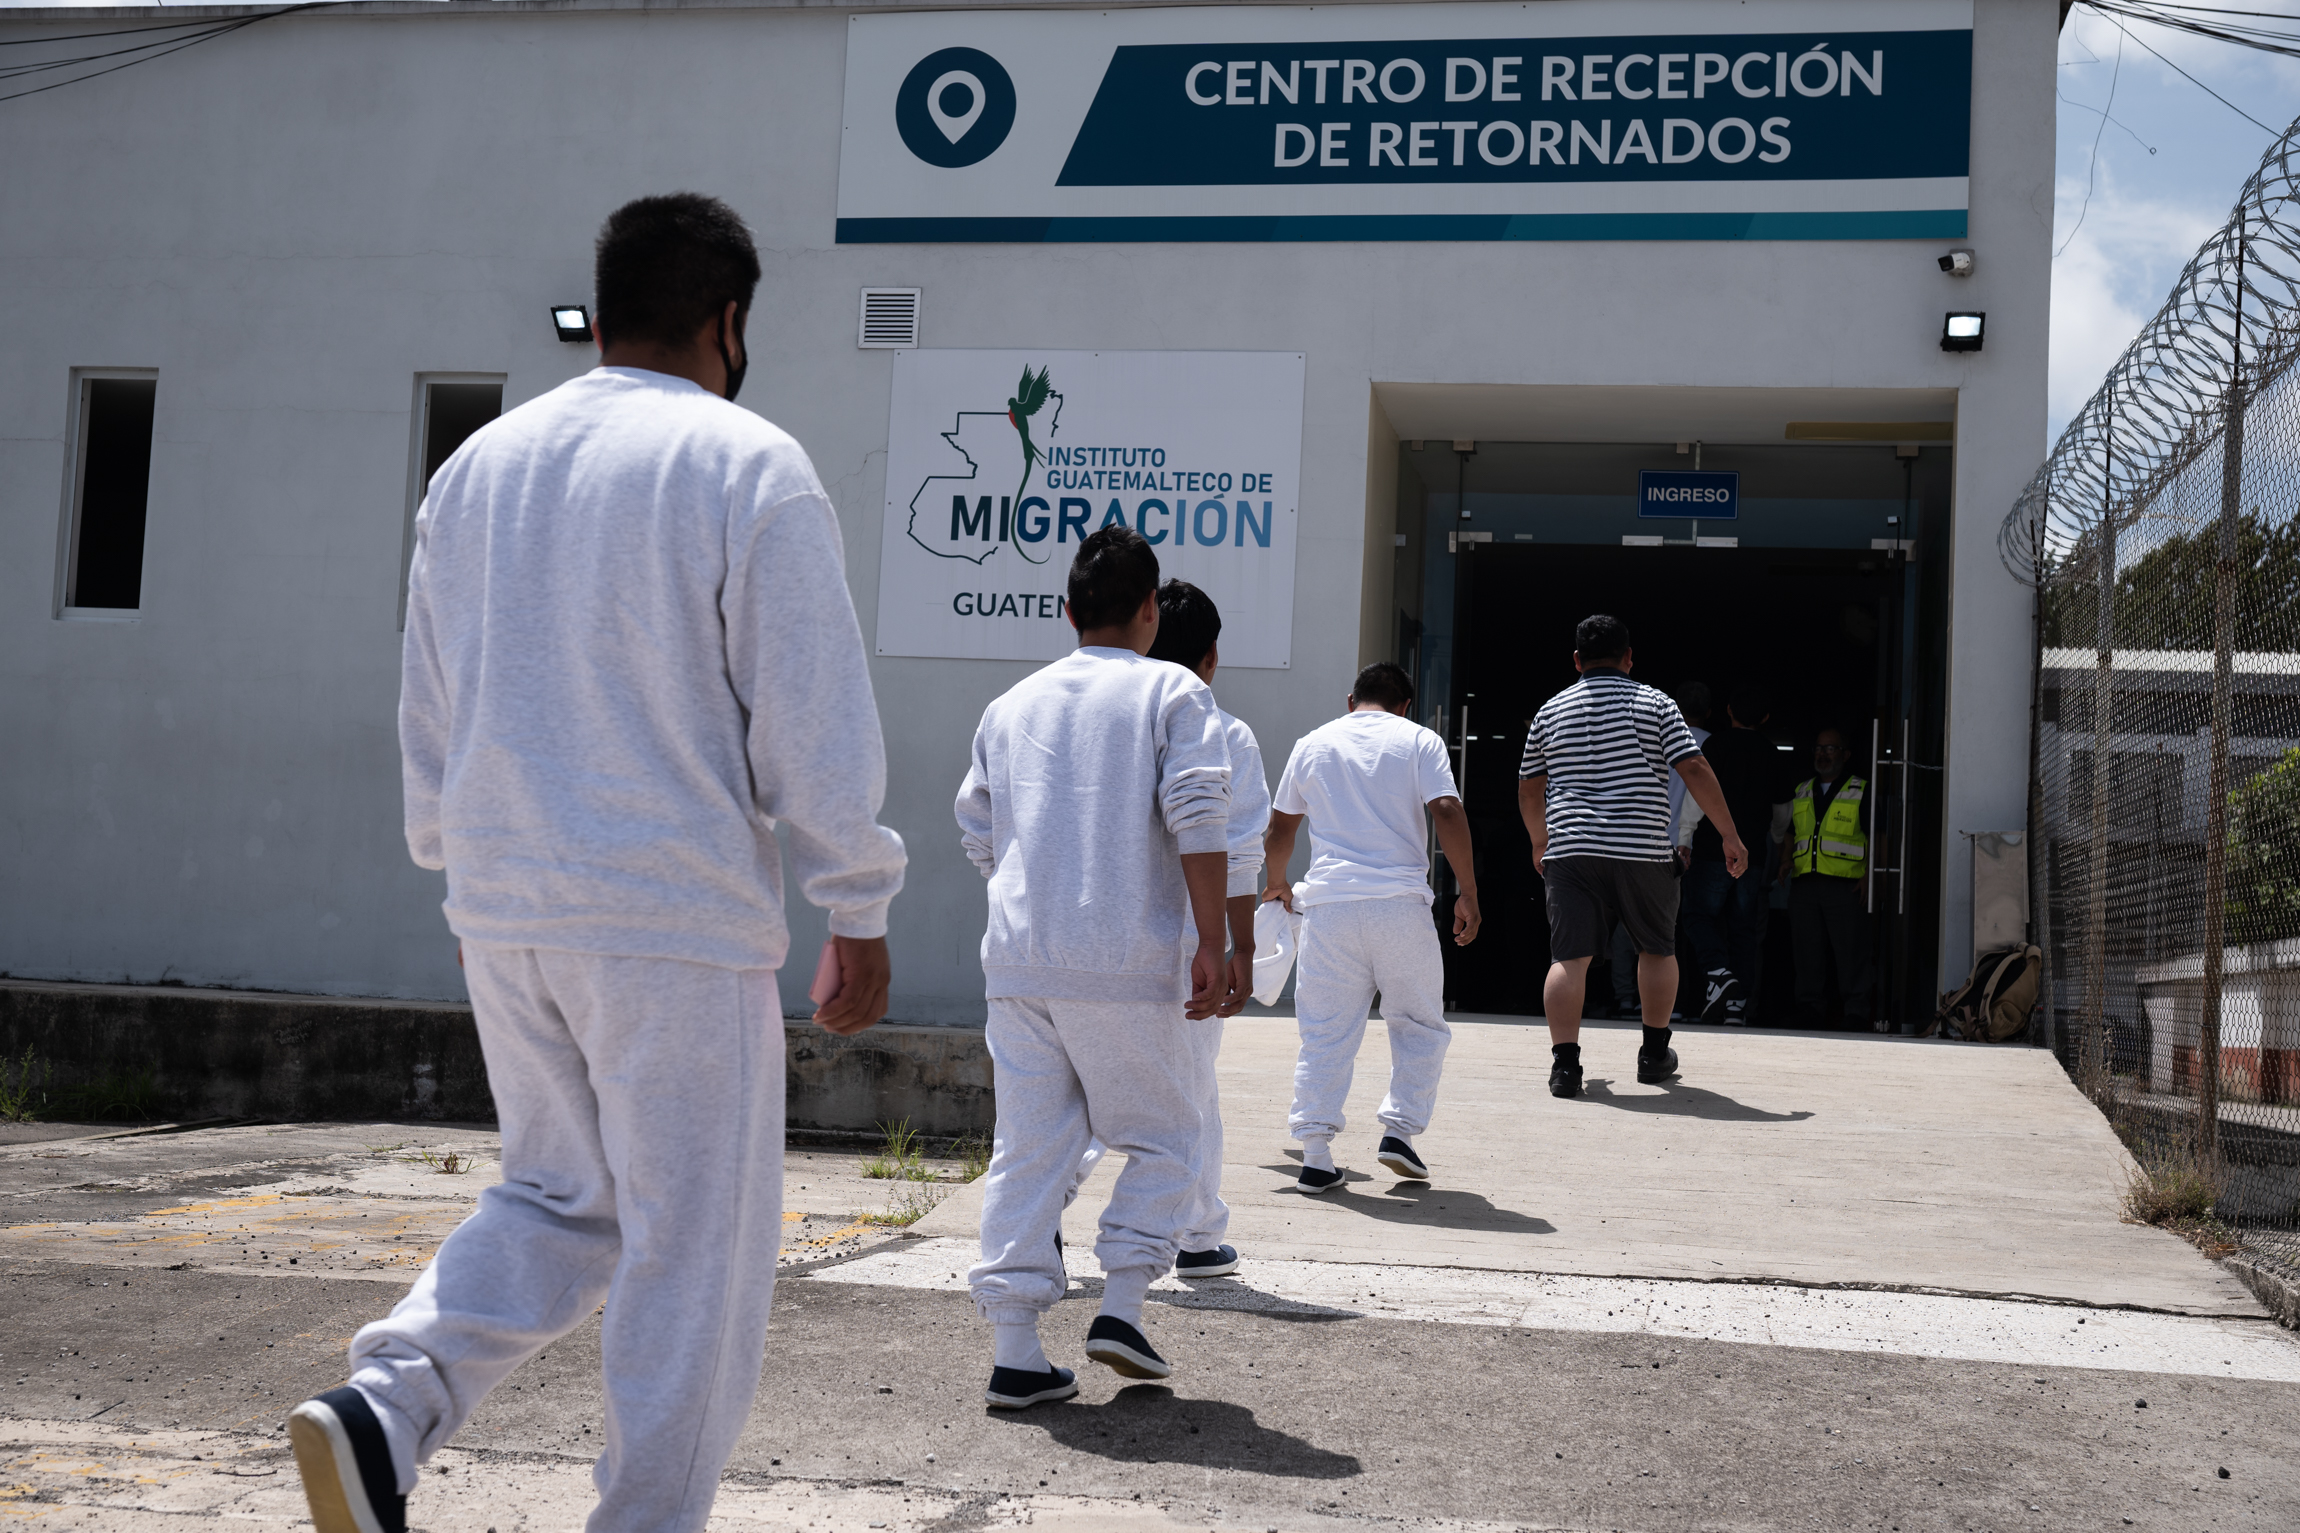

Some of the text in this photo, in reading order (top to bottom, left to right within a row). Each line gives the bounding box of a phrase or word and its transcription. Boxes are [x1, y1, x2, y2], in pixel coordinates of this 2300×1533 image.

[1185, 43, 1883, 105] CENTRO DE RECEPCIÓN
[1274, 117, 1792, 167] DE RETORNADOS
[1048, 446, 1166, 468] INSTITUTO
[1046, 469, 1273, 494] GUATEMALTECO DE
[1647, 487, 1730, 503] INGRESO
